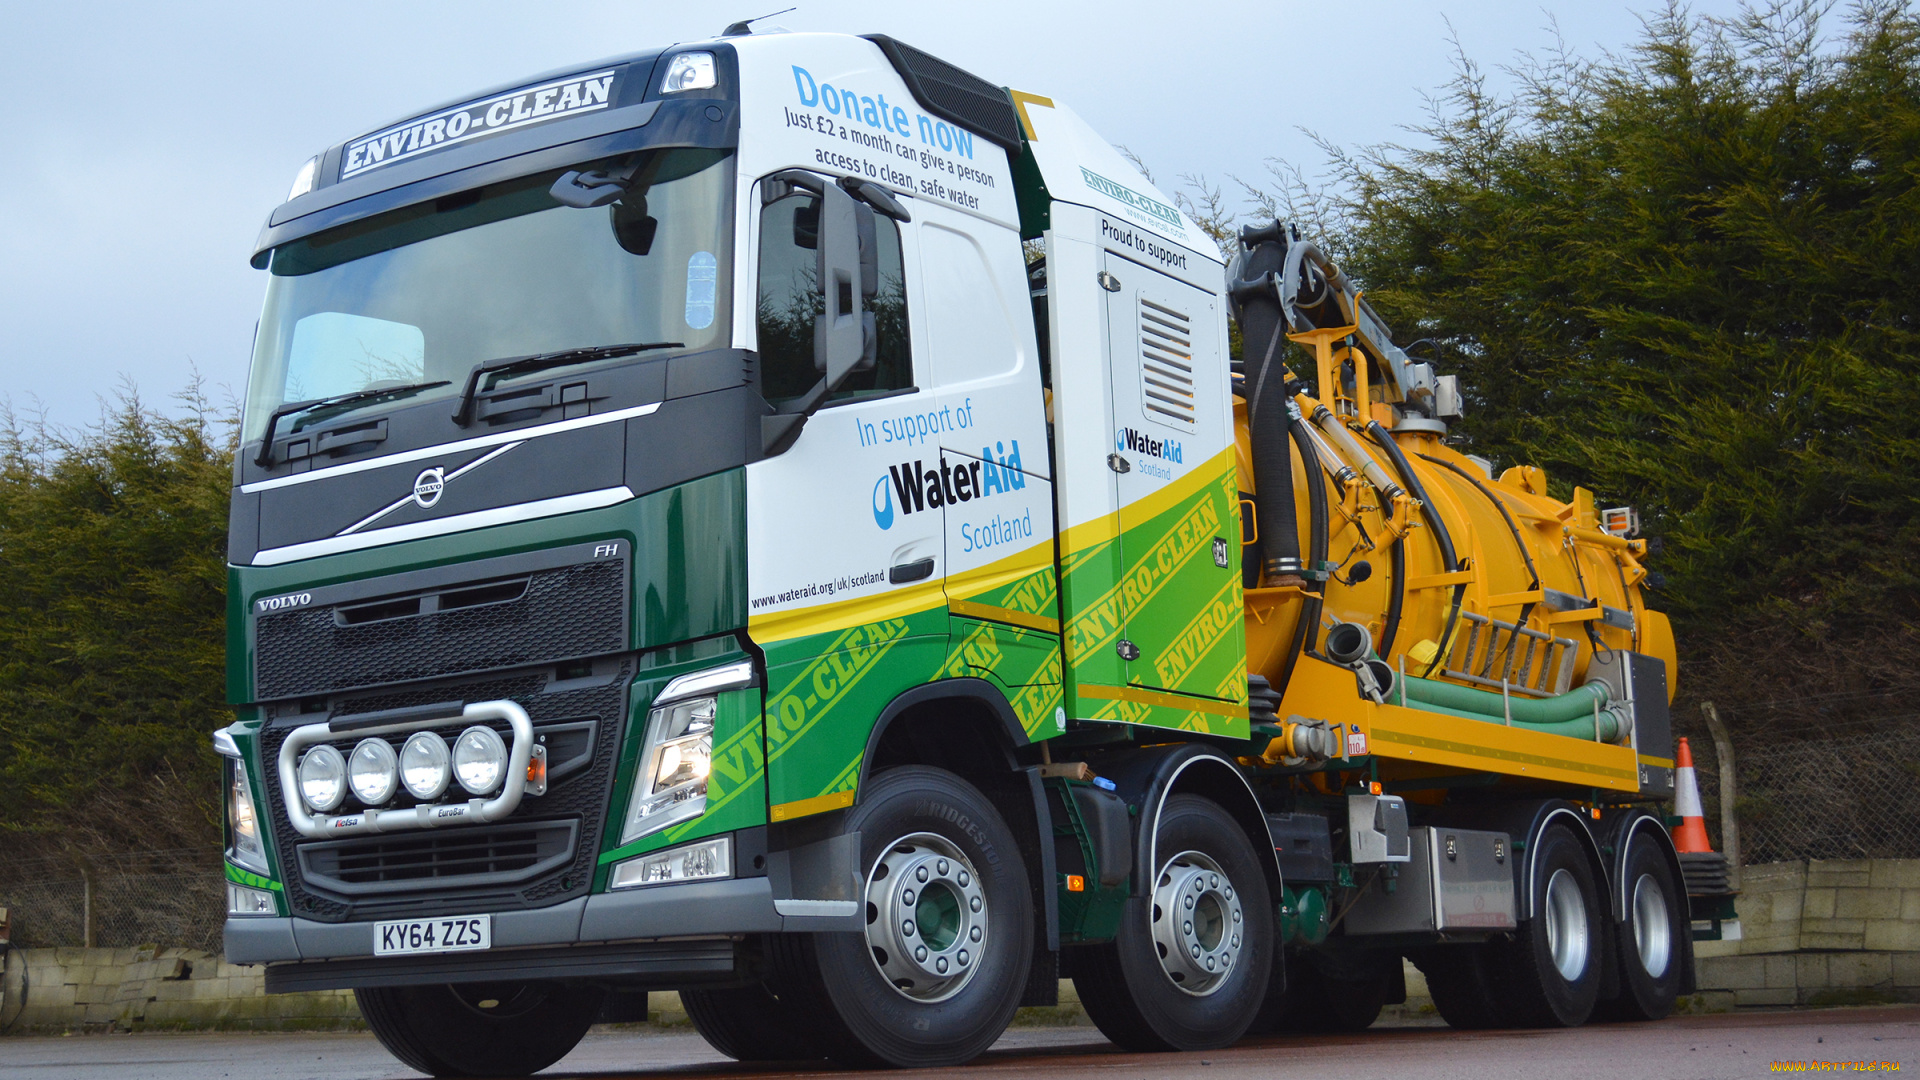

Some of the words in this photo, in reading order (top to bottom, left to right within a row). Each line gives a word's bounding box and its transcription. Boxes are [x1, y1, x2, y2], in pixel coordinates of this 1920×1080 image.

[344, 76, 614, 174] ENVIRO-CLEAN
[792, 65, 911, 138] Donate
[916, 114, 974, 160] now
[784, 106, 814, 131] Just
[816, 115, 836, 137] £2
[839, 124, 848, 141] a
[851, 127, 893, 154] month
[895, 141, 917, 162] can
[920, 149, 945, 171] give
[947, 159, 955, 175] a
[957, 163, 995, 188] person
[815, 148, 861, 173] access
[863, 159, 877, 178] to
[880, 164, 919, 193] clean,
[920, 178, 946, 200] safe
[948, 189, 979, 210] water
[1080, 168, 1183, 227] ENVIRO-CLEAN
[1102, 218, 1133, 247] Proud
[1135, 234, 1145, 252] to
[1148, 242, 1187, 270] support
[856, 417, 877, 447] In
[884, 404, 954, 447] support
[957, 397, 974, 428] of
[1124, 427, 1183, 464] WaterAid
[415, 483, 442, 493] VOLVO
[889, 439, 1026, 515] WaterAid
[1138, 459, 1171, 481] Scotland
[593, 544, 618, 559] FH
[961, 507, 1033, 553] Scotland
[751, 569, 885, 609] www.wateraid.org/uk/scotland
[1064, 497, 1219, 655] ENVIRO-CLEAN
[257, 593, 312, 612] VOLVO
[335, 818, 358, 828] Kelsa
[438, 807, 465, 818] EuroBar
[383, 922, 435, 950] KY64
[442, 919, 481, 946] ZZS
